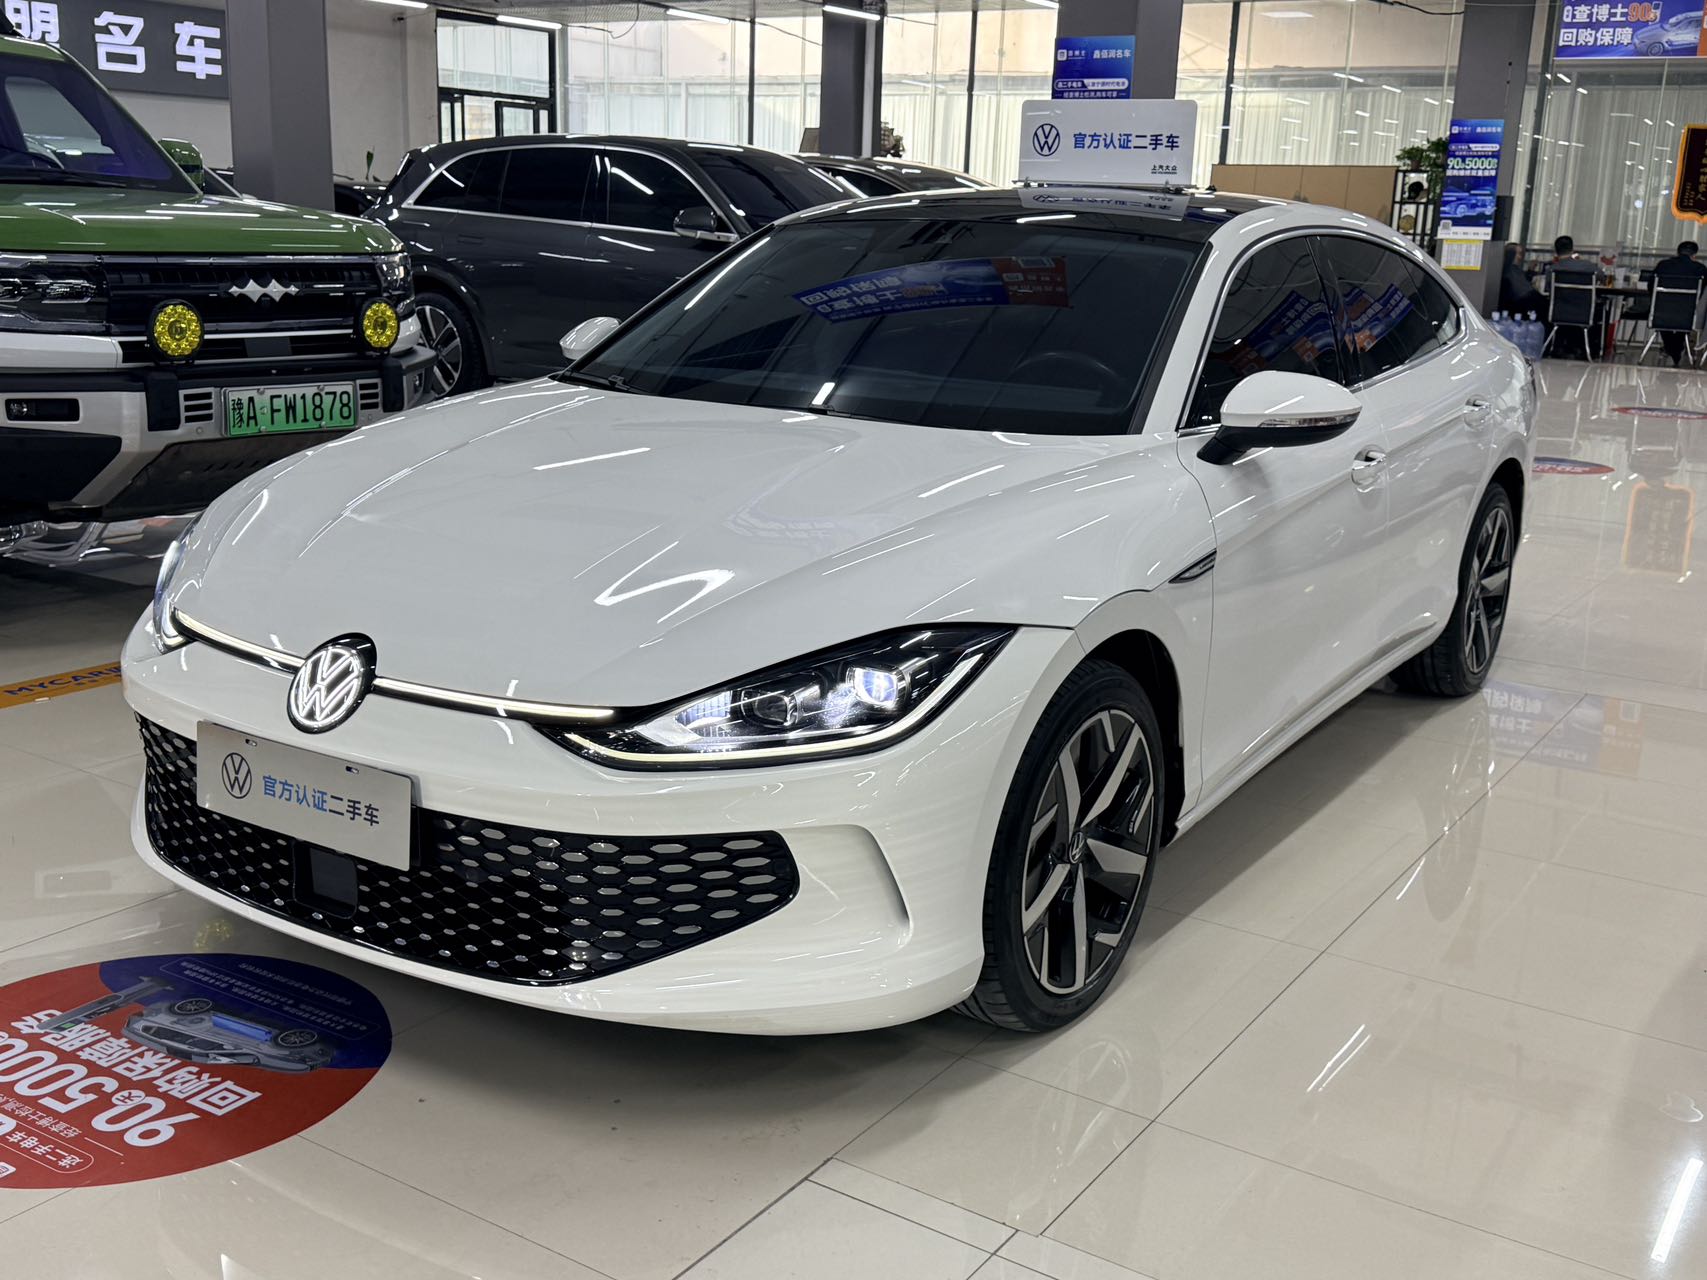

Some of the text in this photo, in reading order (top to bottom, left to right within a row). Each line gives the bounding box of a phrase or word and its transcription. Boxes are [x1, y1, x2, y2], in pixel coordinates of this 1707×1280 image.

[1558, 26, 1633, 47] 回购保障
[1072, 131, 1180, 151] 官方认证二手车
[262, 774, 380, 827] 官方认证二手车
[5, 1130, 84, 1169] 选二手电车
